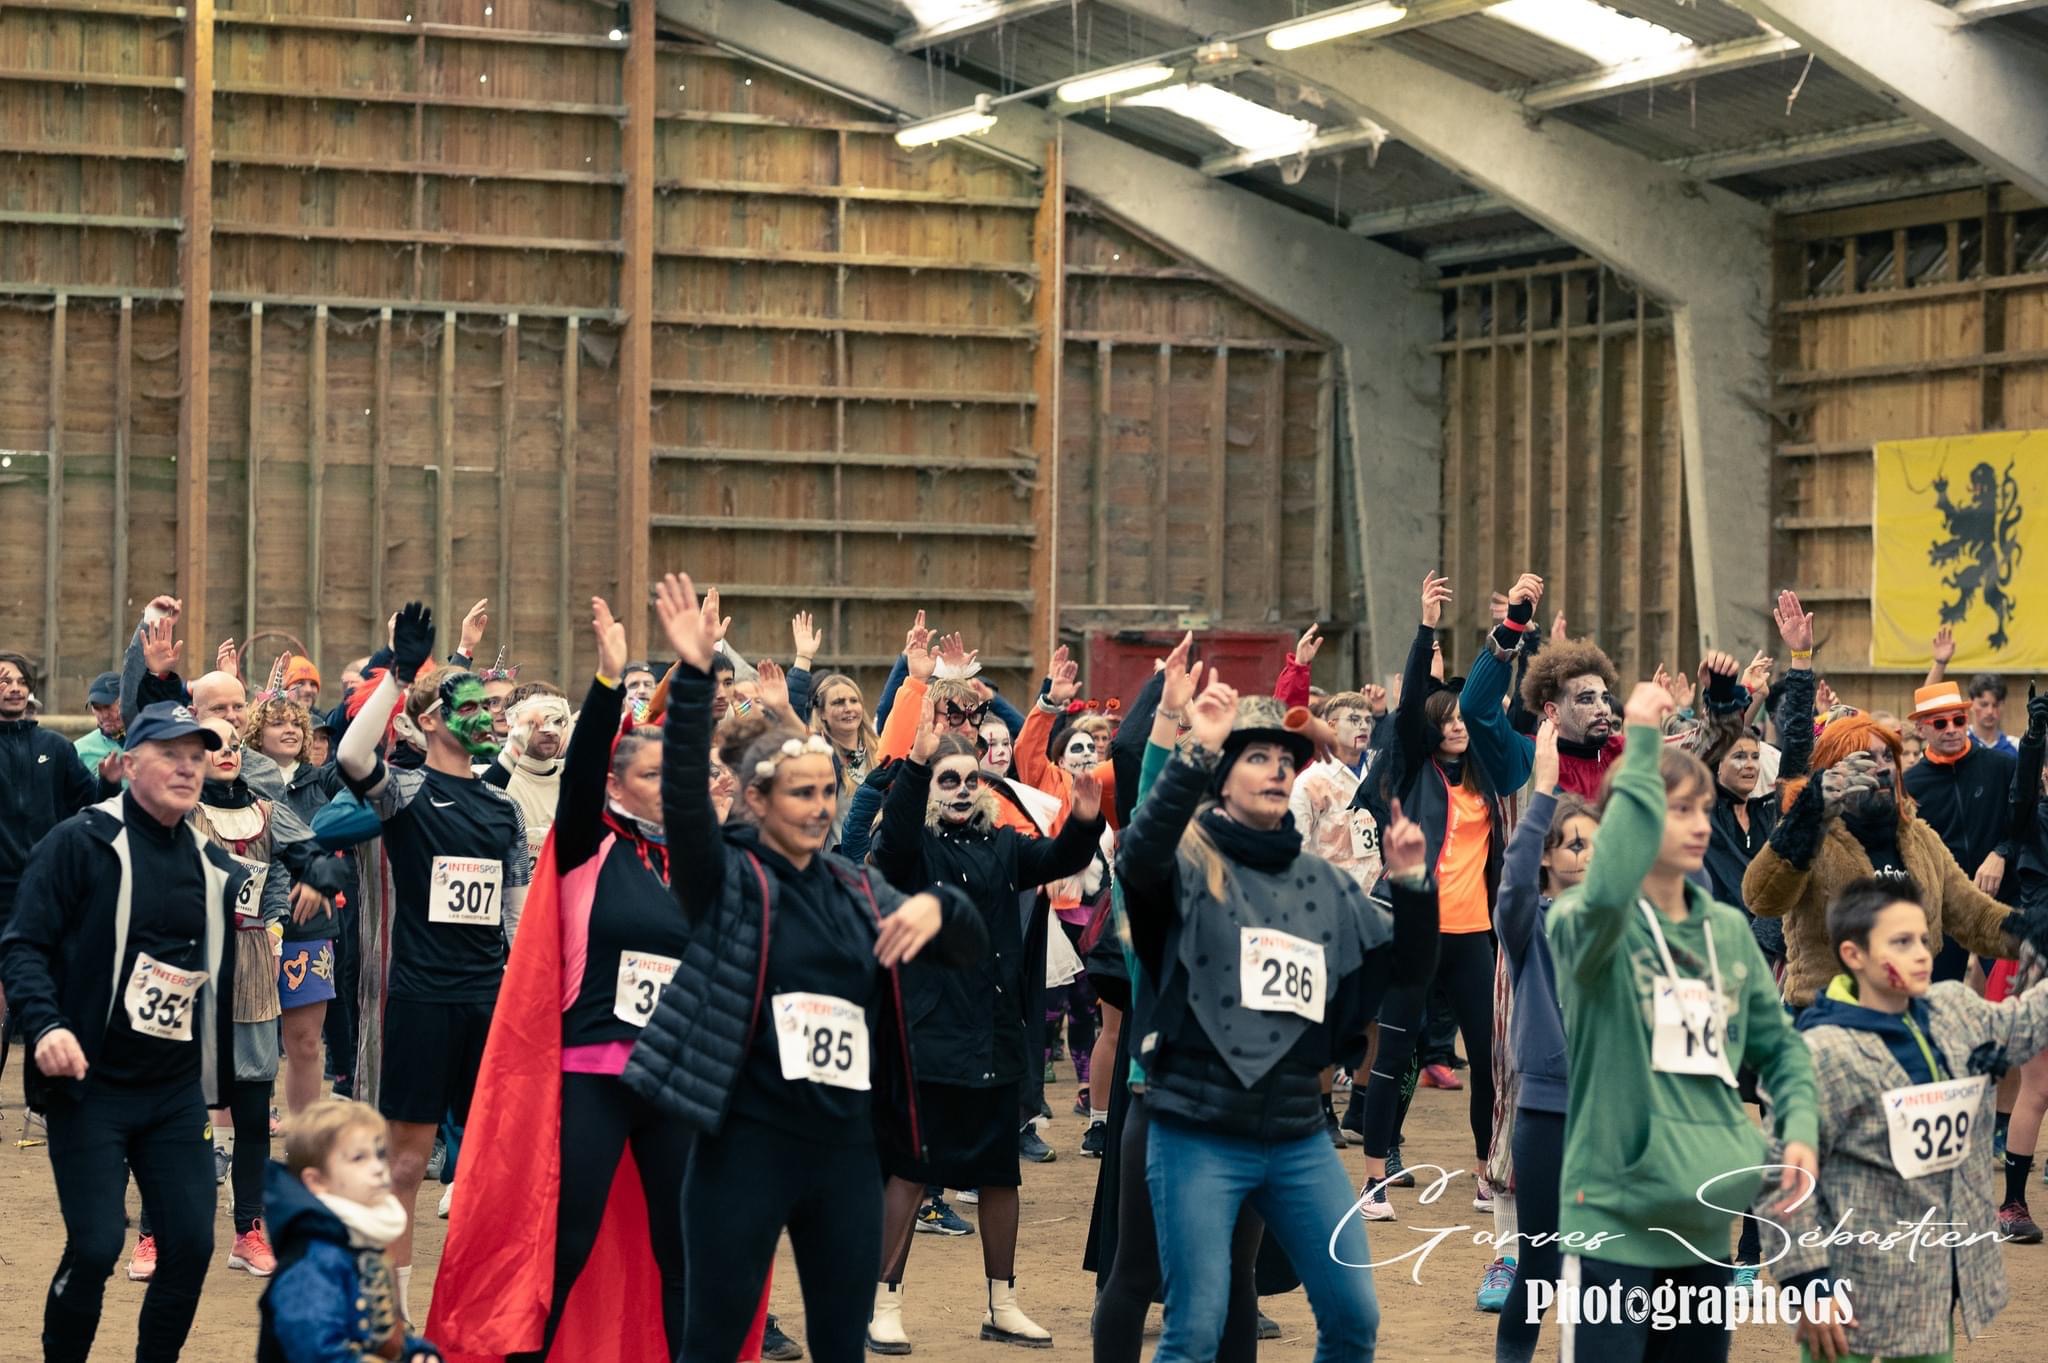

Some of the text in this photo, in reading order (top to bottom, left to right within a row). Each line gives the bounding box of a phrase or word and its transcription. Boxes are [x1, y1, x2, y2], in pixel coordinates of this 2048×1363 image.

[448, 862, 499, 874] INTERSPO
[448, 880, 495, 914] 307
[152, 966, 203, 988] INTERS
[1262, 958, 1312, 1004] 286
[1912, 1110, 1969, 1160] 329
